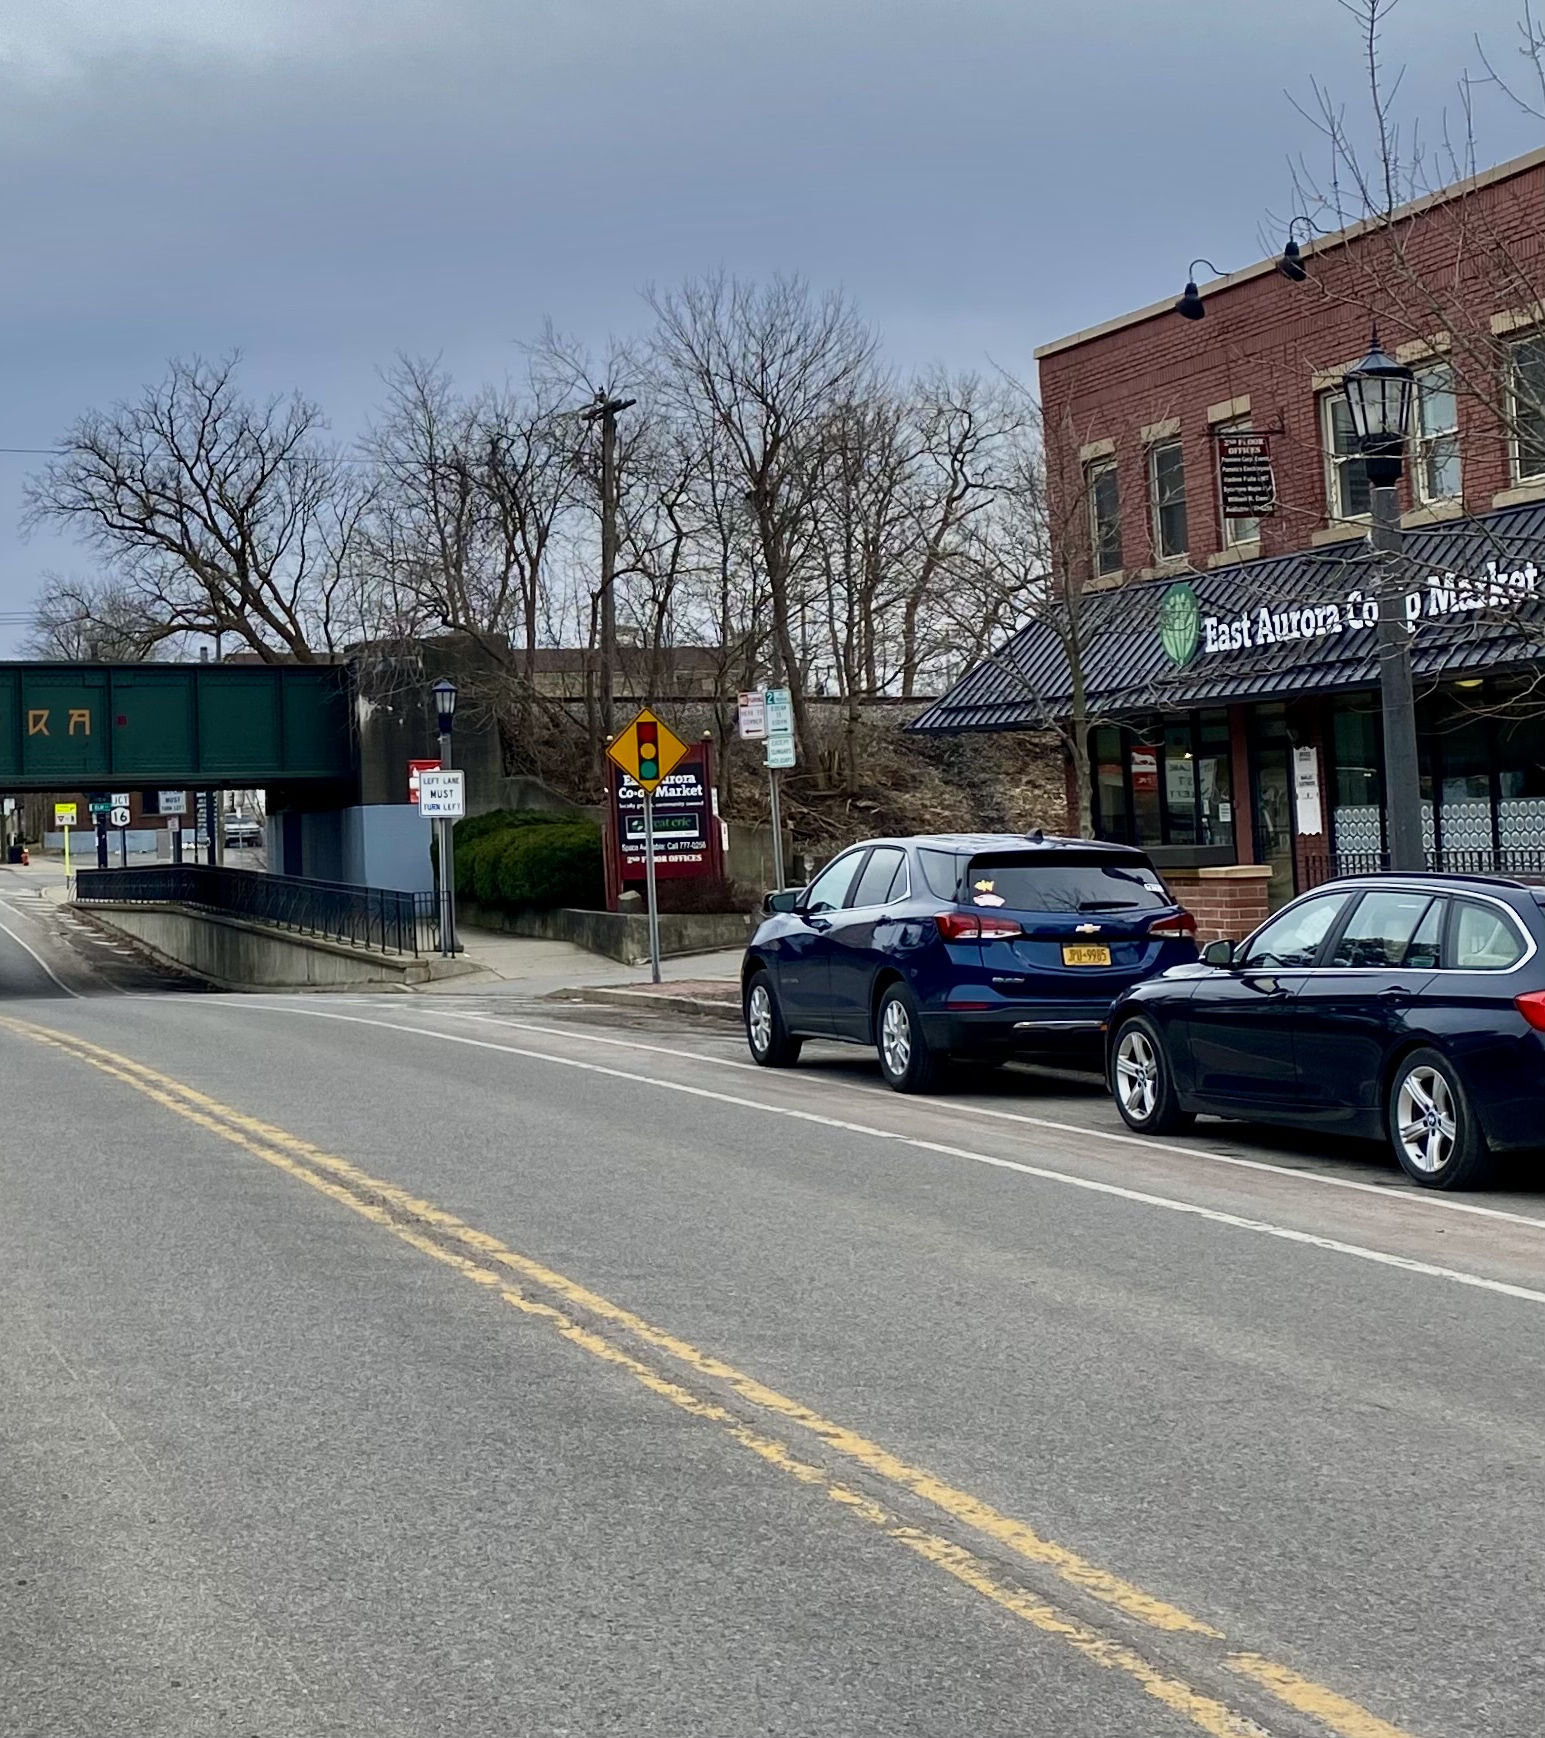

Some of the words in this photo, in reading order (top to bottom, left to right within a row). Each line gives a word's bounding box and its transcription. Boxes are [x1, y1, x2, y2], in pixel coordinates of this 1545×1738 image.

[1228, 446, 1261, 454] OFFICES
[1204, 612, 1252, 653] East
[1255, 603, 1343, 646] Aurora
[1347, 591, 1421, 634] Cop
[1427, 561, 1540, 617] Market
[766, 692, 774, 704] 2
[423, 777, 439, 785] LEFT
[443, 777, 460, 785] LANE
[662, 774, 697, 785] urora
[430, 789, 454, 799] MUST
[655, 784, 703, 798] Market
[114, 795, 128, 805] JCT
[423, 803, 441, 811] TURN
[443, 803, 461, 811] LEFT
[113, 811, 128, 823] 16
[621, 843, 639, 852] Space
[667, 842, 679, 850] Call
[668, 854, 703, 862] OFFICES
